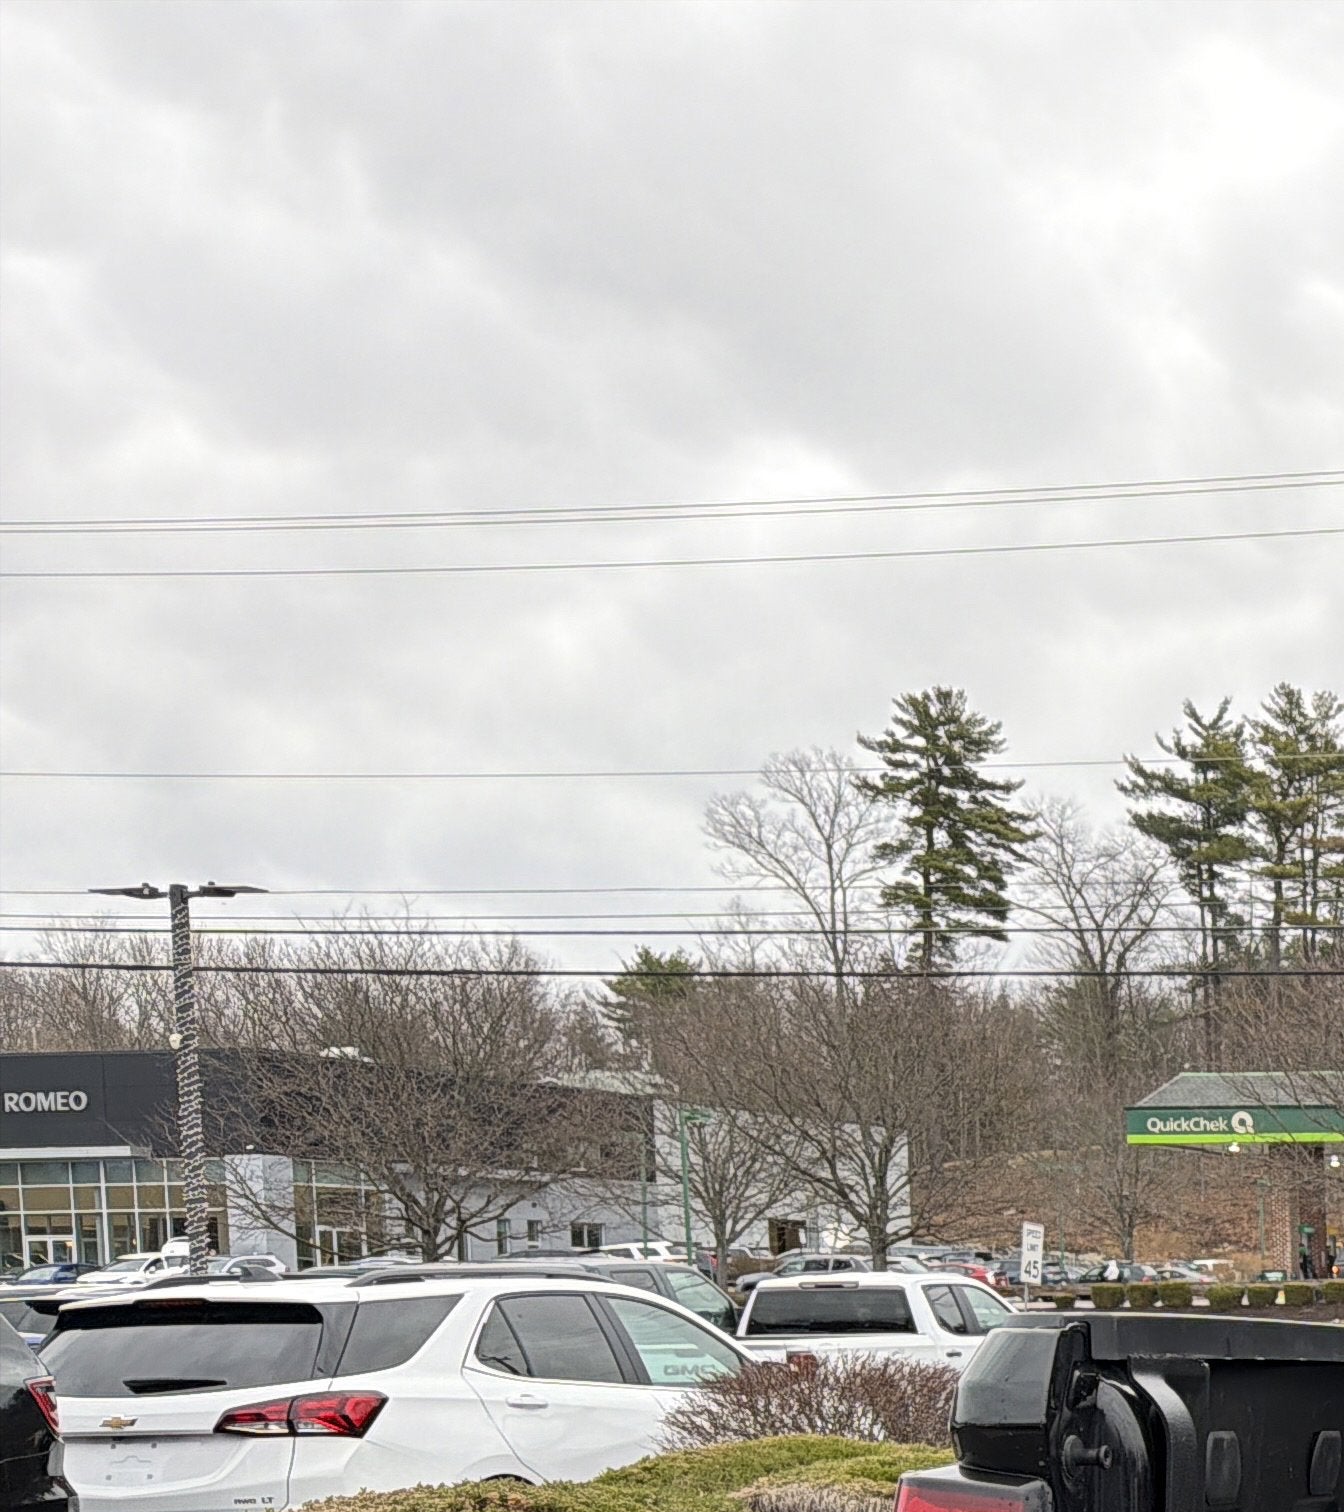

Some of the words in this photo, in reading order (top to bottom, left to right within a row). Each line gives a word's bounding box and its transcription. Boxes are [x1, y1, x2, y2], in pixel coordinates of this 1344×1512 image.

[3, 1090, 88, 1112] ROMEO
[1146, 1116, 1229, 1133] QuickChek
[1024, 1259, 1040, 1279] 45
[662, 1364, 716, 1376] GMC
[261, 1496, 275, 1505] LT
